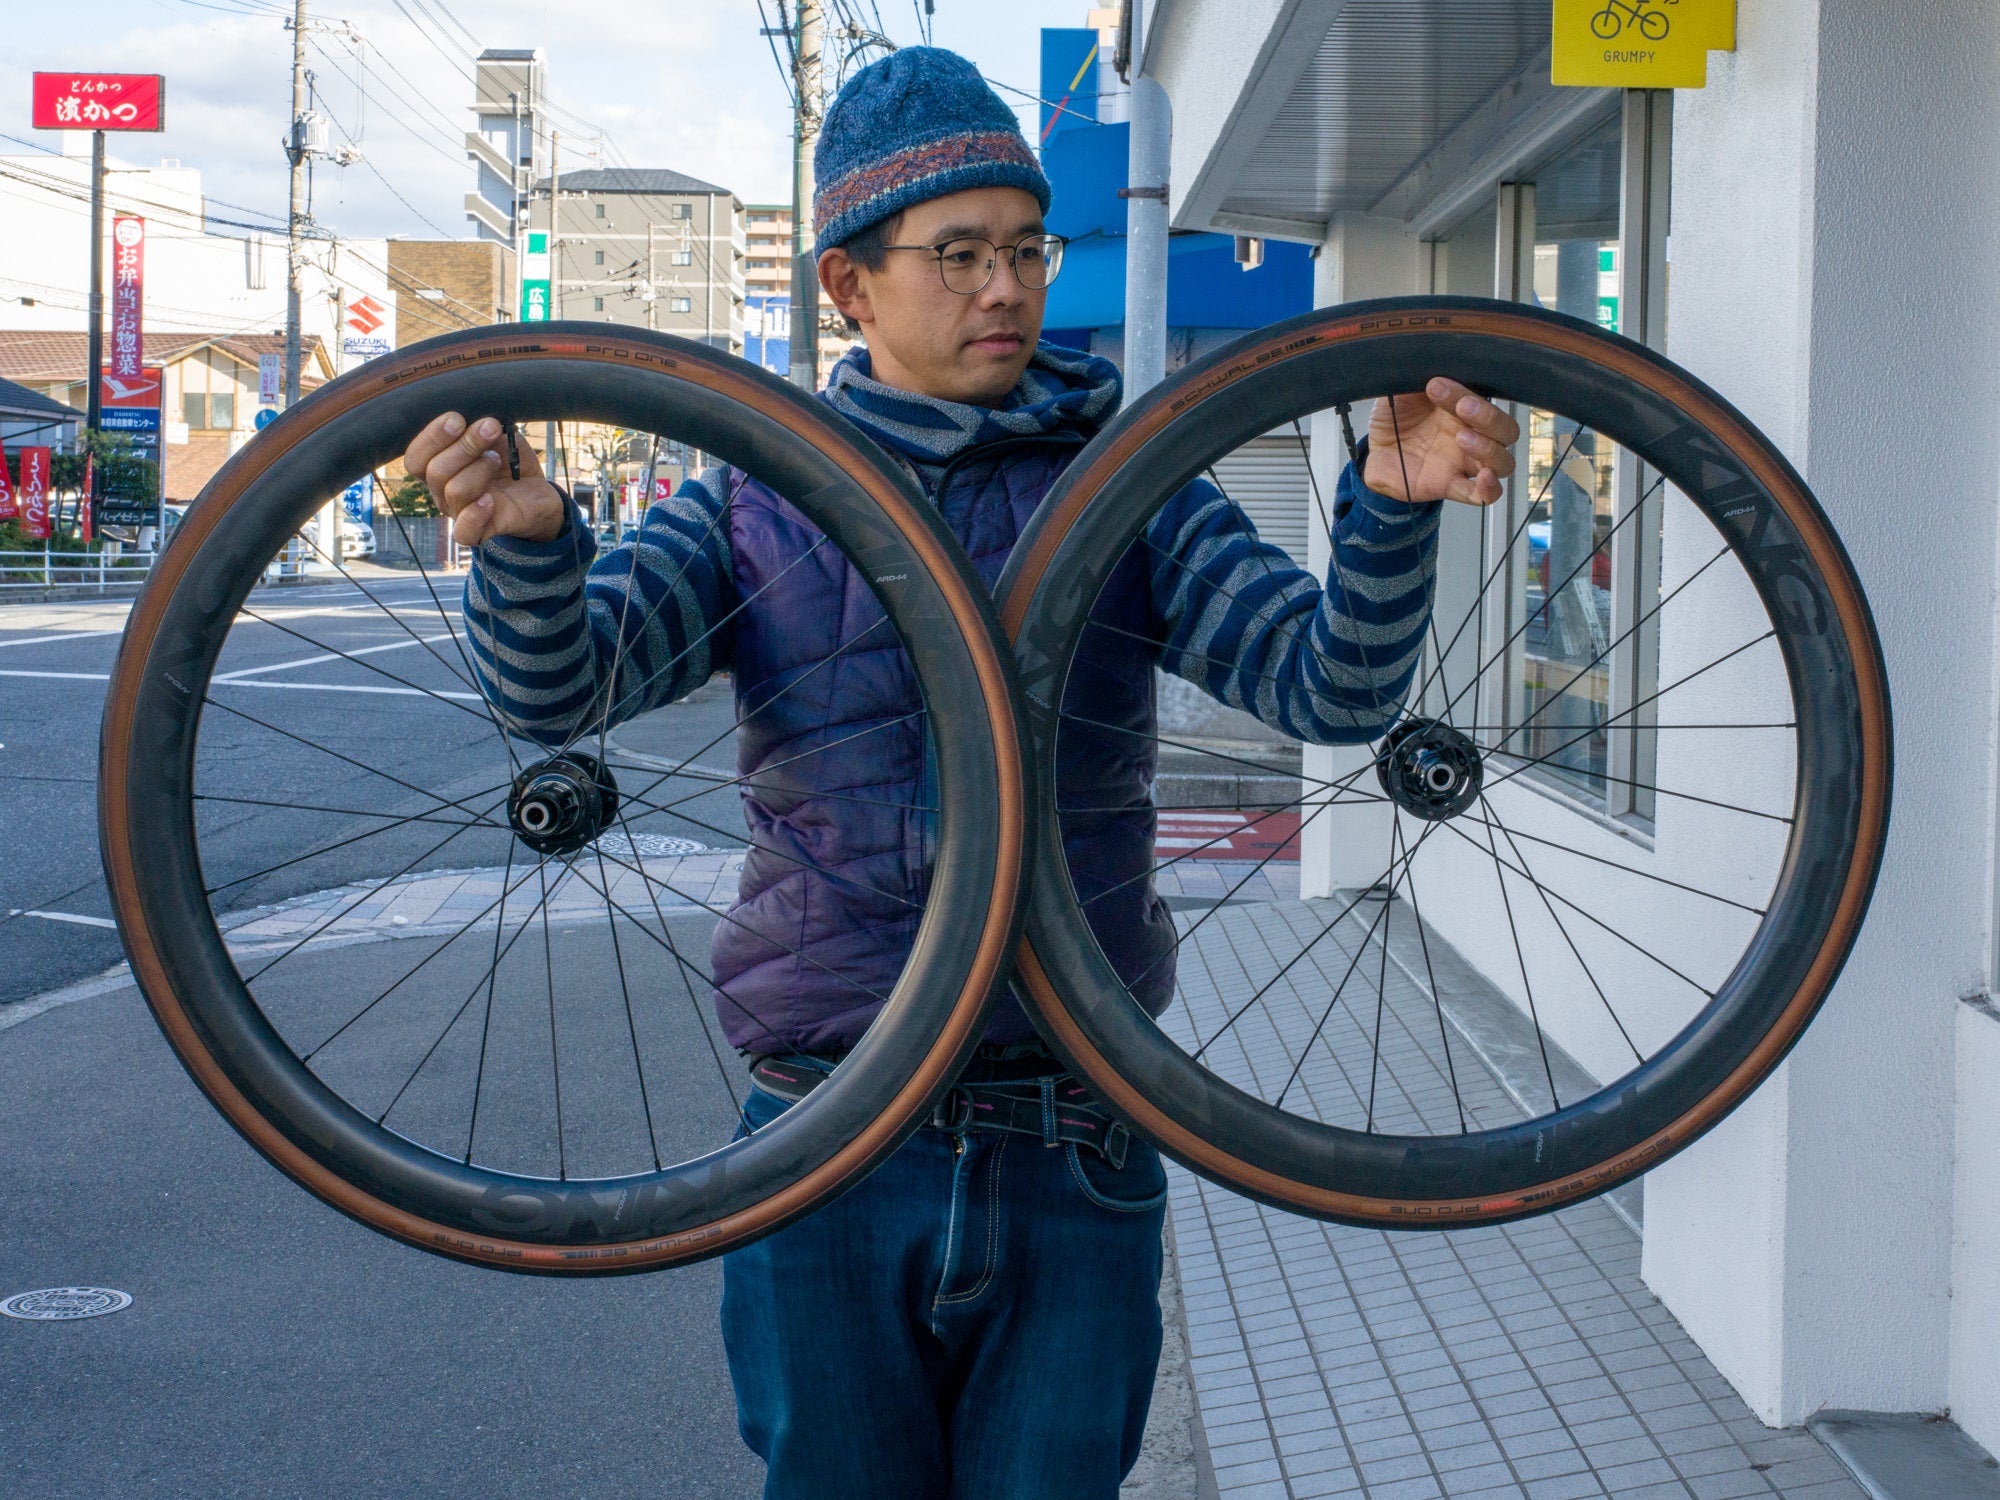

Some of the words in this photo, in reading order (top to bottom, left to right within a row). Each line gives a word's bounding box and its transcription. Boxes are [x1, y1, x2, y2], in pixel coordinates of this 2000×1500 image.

[1603, 50, 1656, 63] GRUMPY
[71, 80, 122, 93] とんかつ
[56, 96, 138, 122] 濱かつ
[116, 247, 139, 376] お弁当・お惣菜
[527, 287, 545, 322] 広島
[344, 337, 387, 345] SUZUKI
[383, 347, 506, 384] SCHWALBE
[1170, 345, 1286, 413] SCHWALBE
[875, 573, 908, 583] ARD44
[1557, 1135, 1671, 1196] SCHWALBE
[600, 1226, 722, 1257] SCHWALBE
